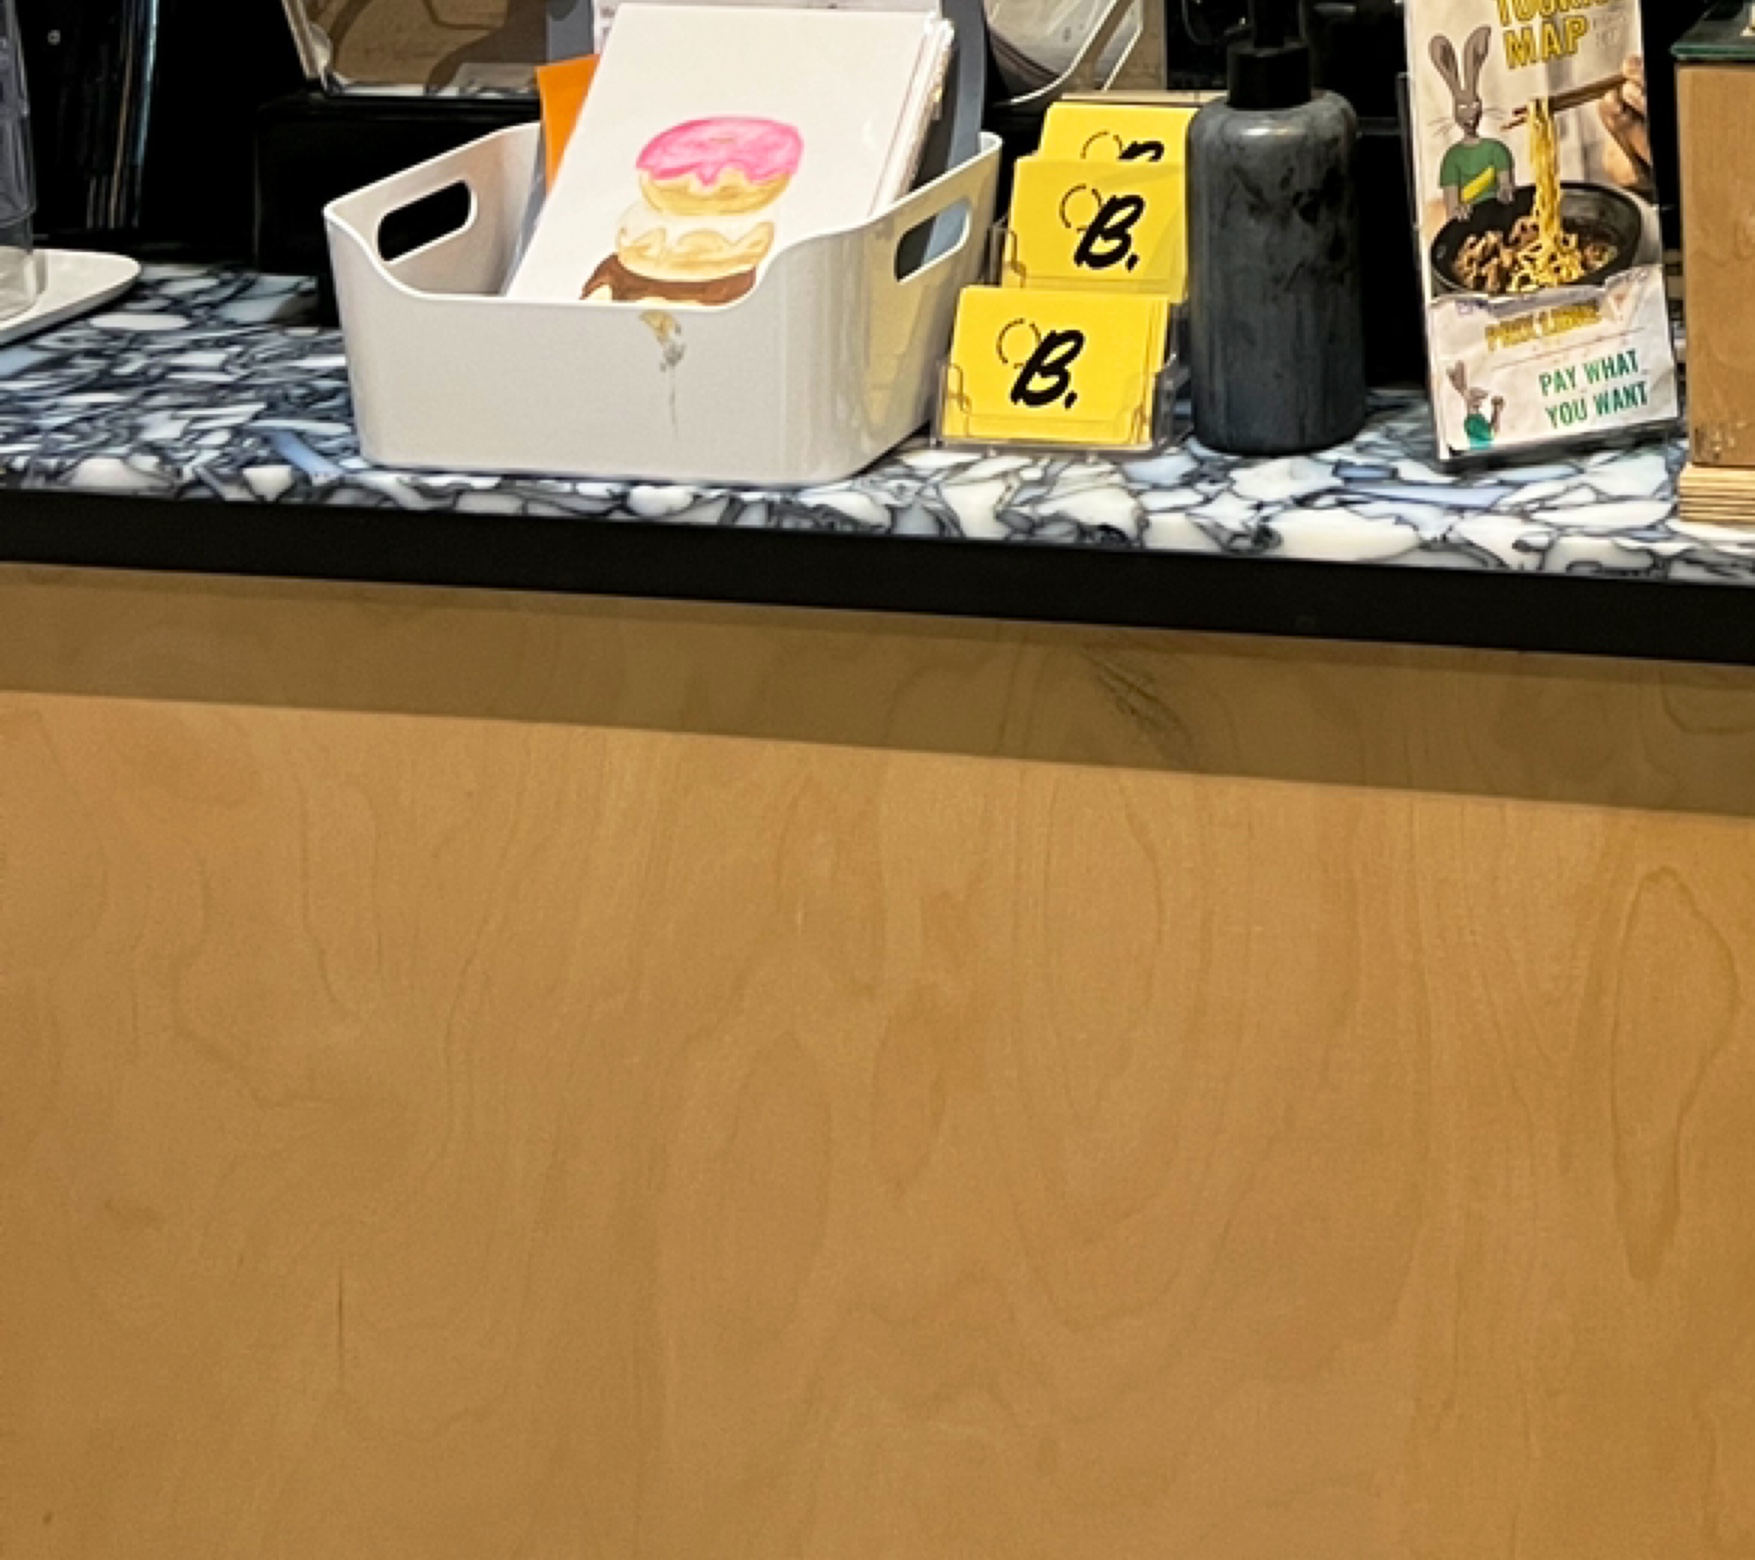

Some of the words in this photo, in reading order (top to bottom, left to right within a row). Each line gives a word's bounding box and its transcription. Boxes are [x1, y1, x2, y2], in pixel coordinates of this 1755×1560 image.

[1502, 14, 1589, 70] MAP
[1074, 194, 1145, 272] B.
[1010, 329, 1084, 409] B.
[1538, 364, 1577, 397] PAY
[1583, 347, 1640, 385] WHAT
[1545, 395, 1588, 430] YOU
[1593, 380, 1649, 417] WANT
